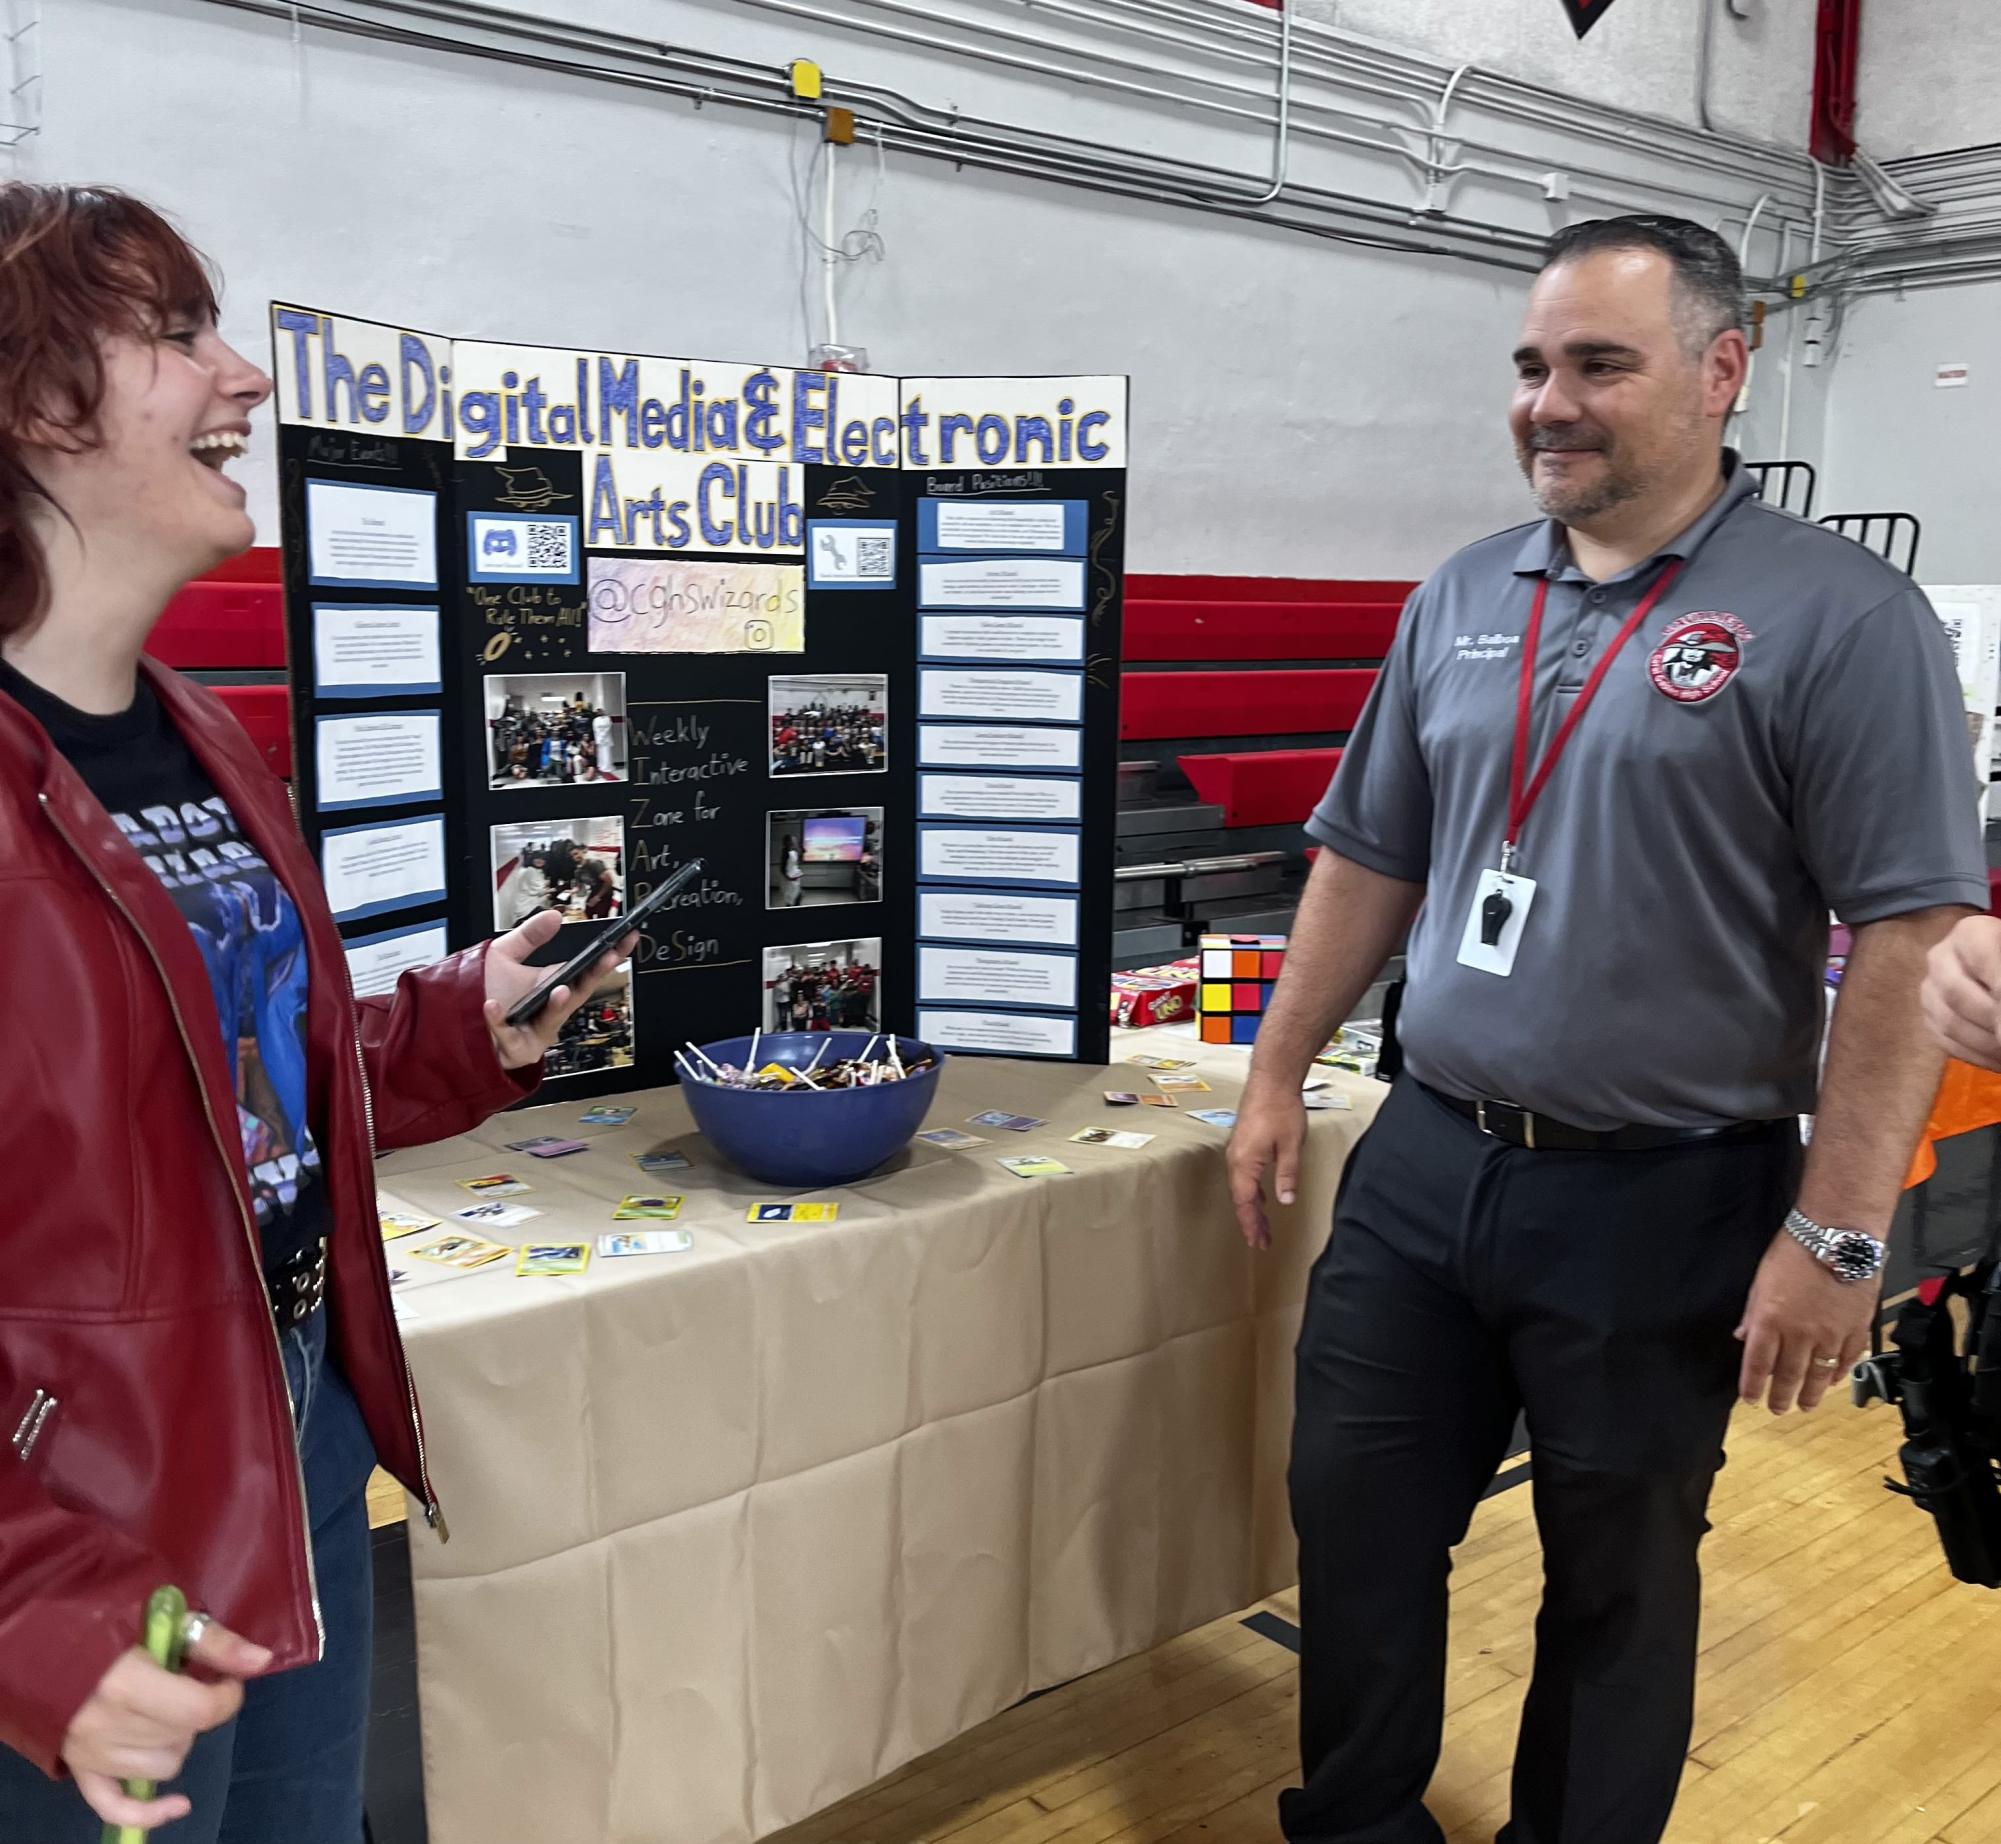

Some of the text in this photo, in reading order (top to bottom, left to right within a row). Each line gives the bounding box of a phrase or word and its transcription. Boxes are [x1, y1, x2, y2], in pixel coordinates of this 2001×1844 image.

[277, 309, 1111, 467] The Digital Media & Electronic
[588, 453, 805, 549] Arts Club
[926, 475, 965, 493] Board
[506, 585, 543, 606] Club
[627, 714, 710, 750] Weekly
[632, 752, 750, 786] Interactive
[629, 789, 722, 829] Zone for
